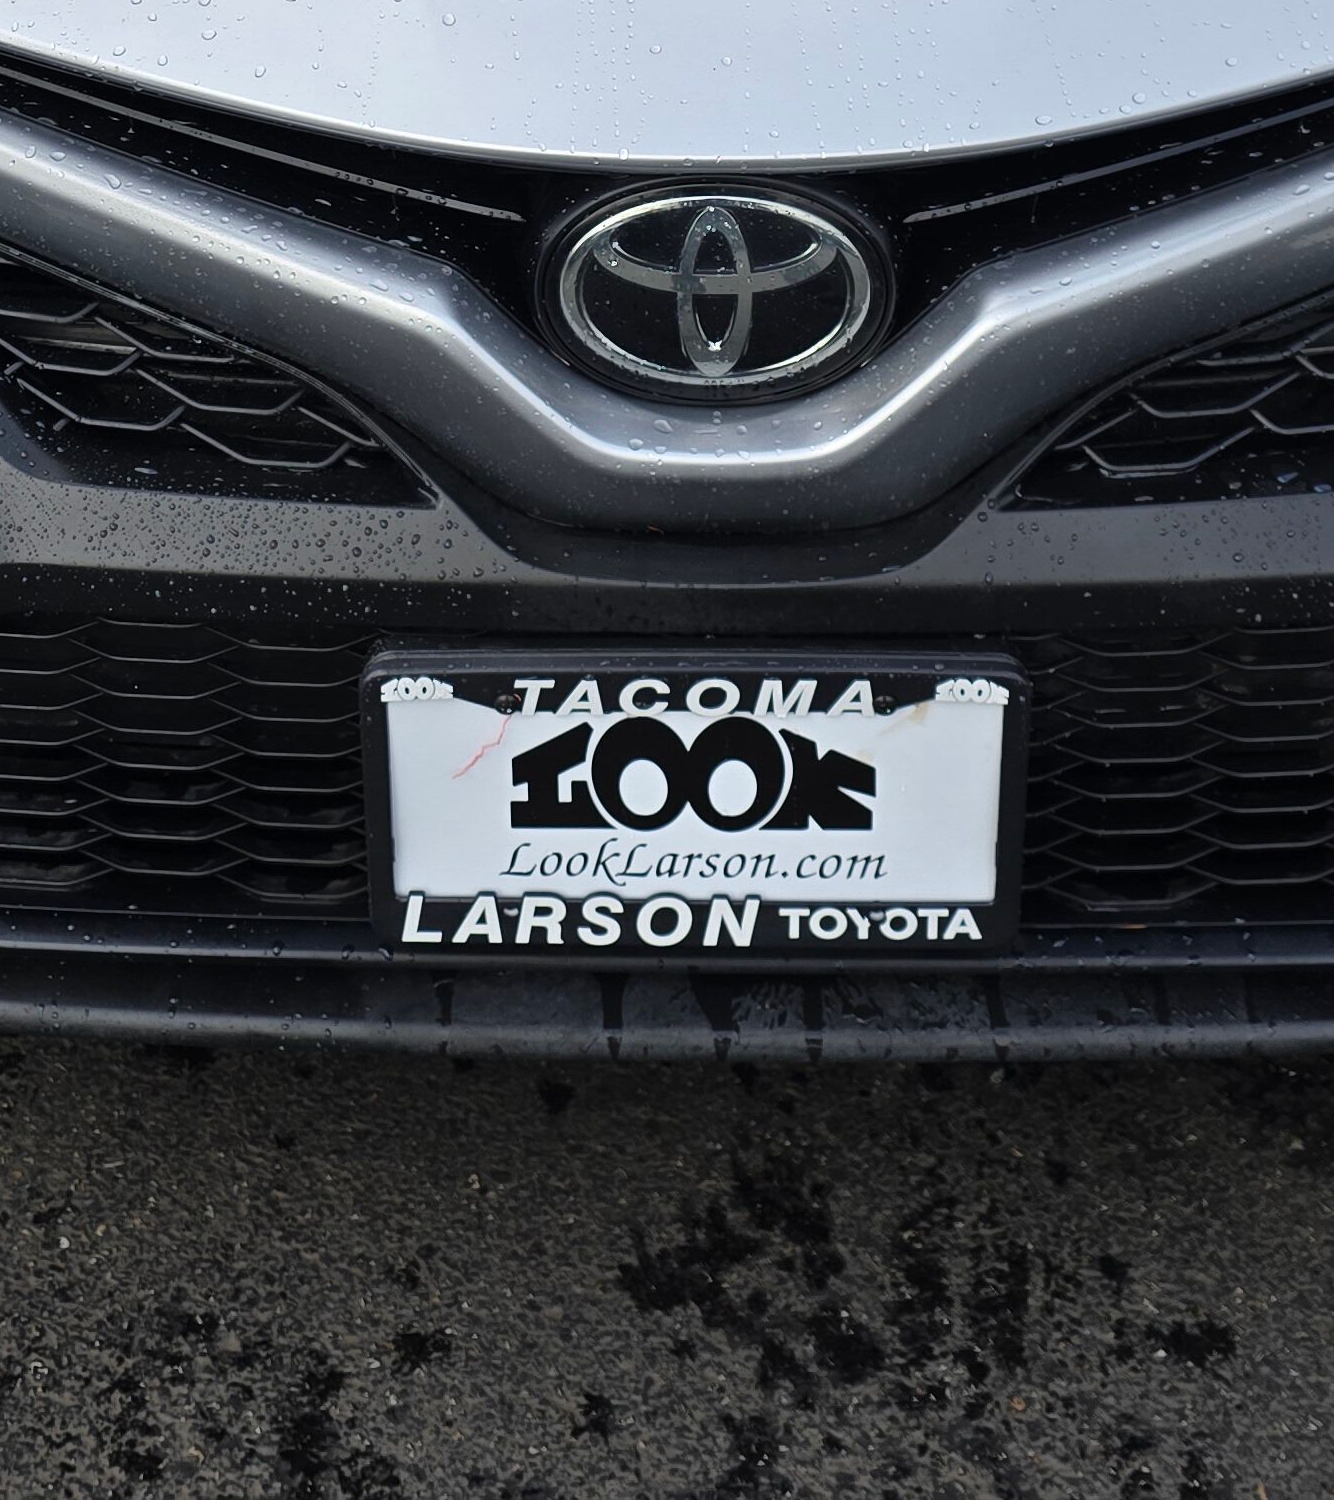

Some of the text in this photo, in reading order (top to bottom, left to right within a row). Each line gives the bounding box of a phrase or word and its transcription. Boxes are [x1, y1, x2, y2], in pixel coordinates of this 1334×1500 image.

[513, 679, 875, 717] TACOMA
[499, 837, 888, 886] LookLarson.com
[401, 893, 983, 947] LARSON TOYOTA
